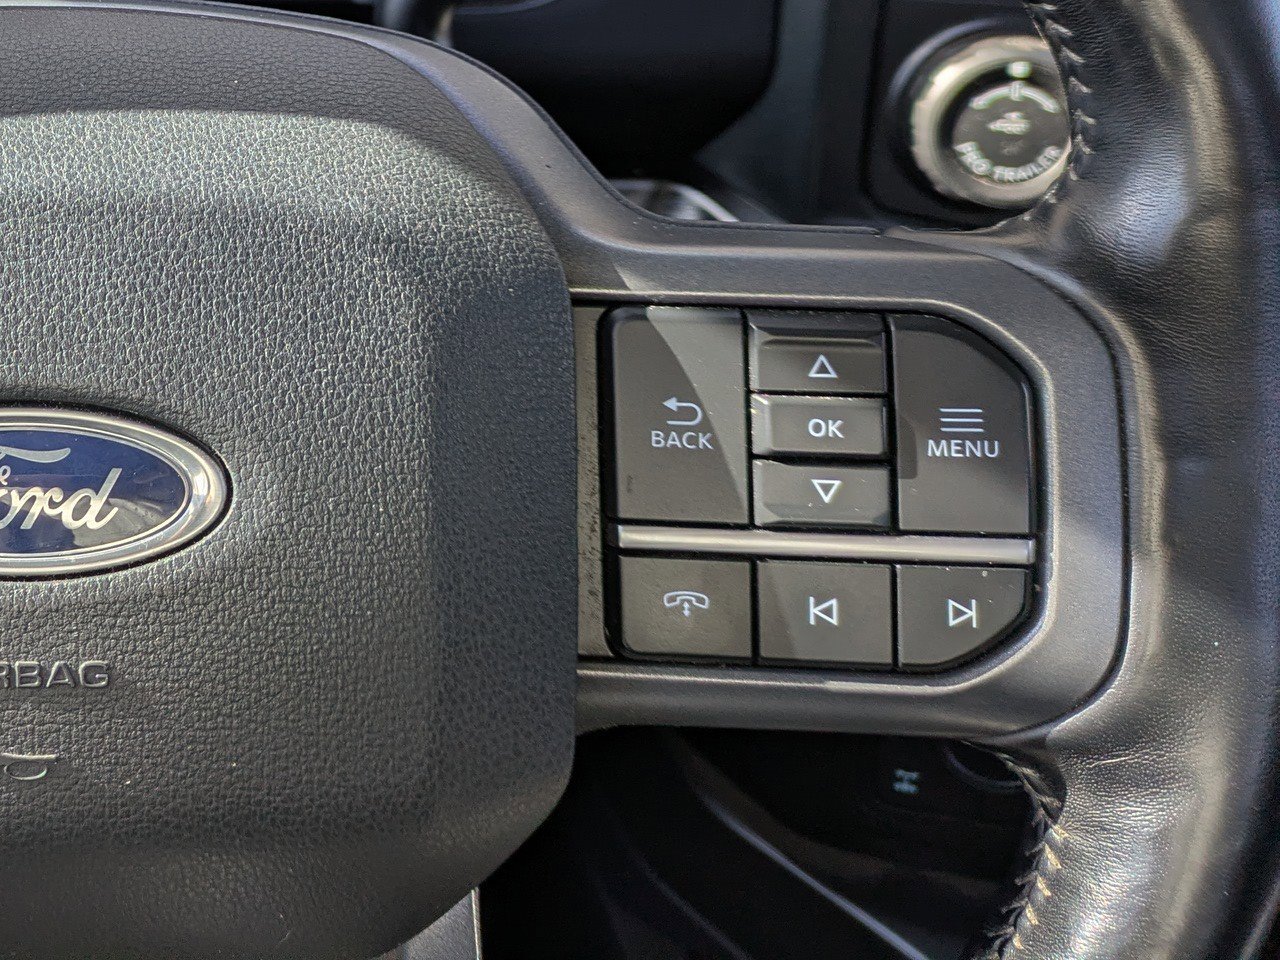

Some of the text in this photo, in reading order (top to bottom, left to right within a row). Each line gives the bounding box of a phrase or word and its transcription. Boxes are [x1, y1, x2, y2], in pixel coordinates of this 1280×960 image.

[808, 418, 844, 439] OK
[651, 430, 714, 451] BACK
[927, 439, 1000, 459] MENU
